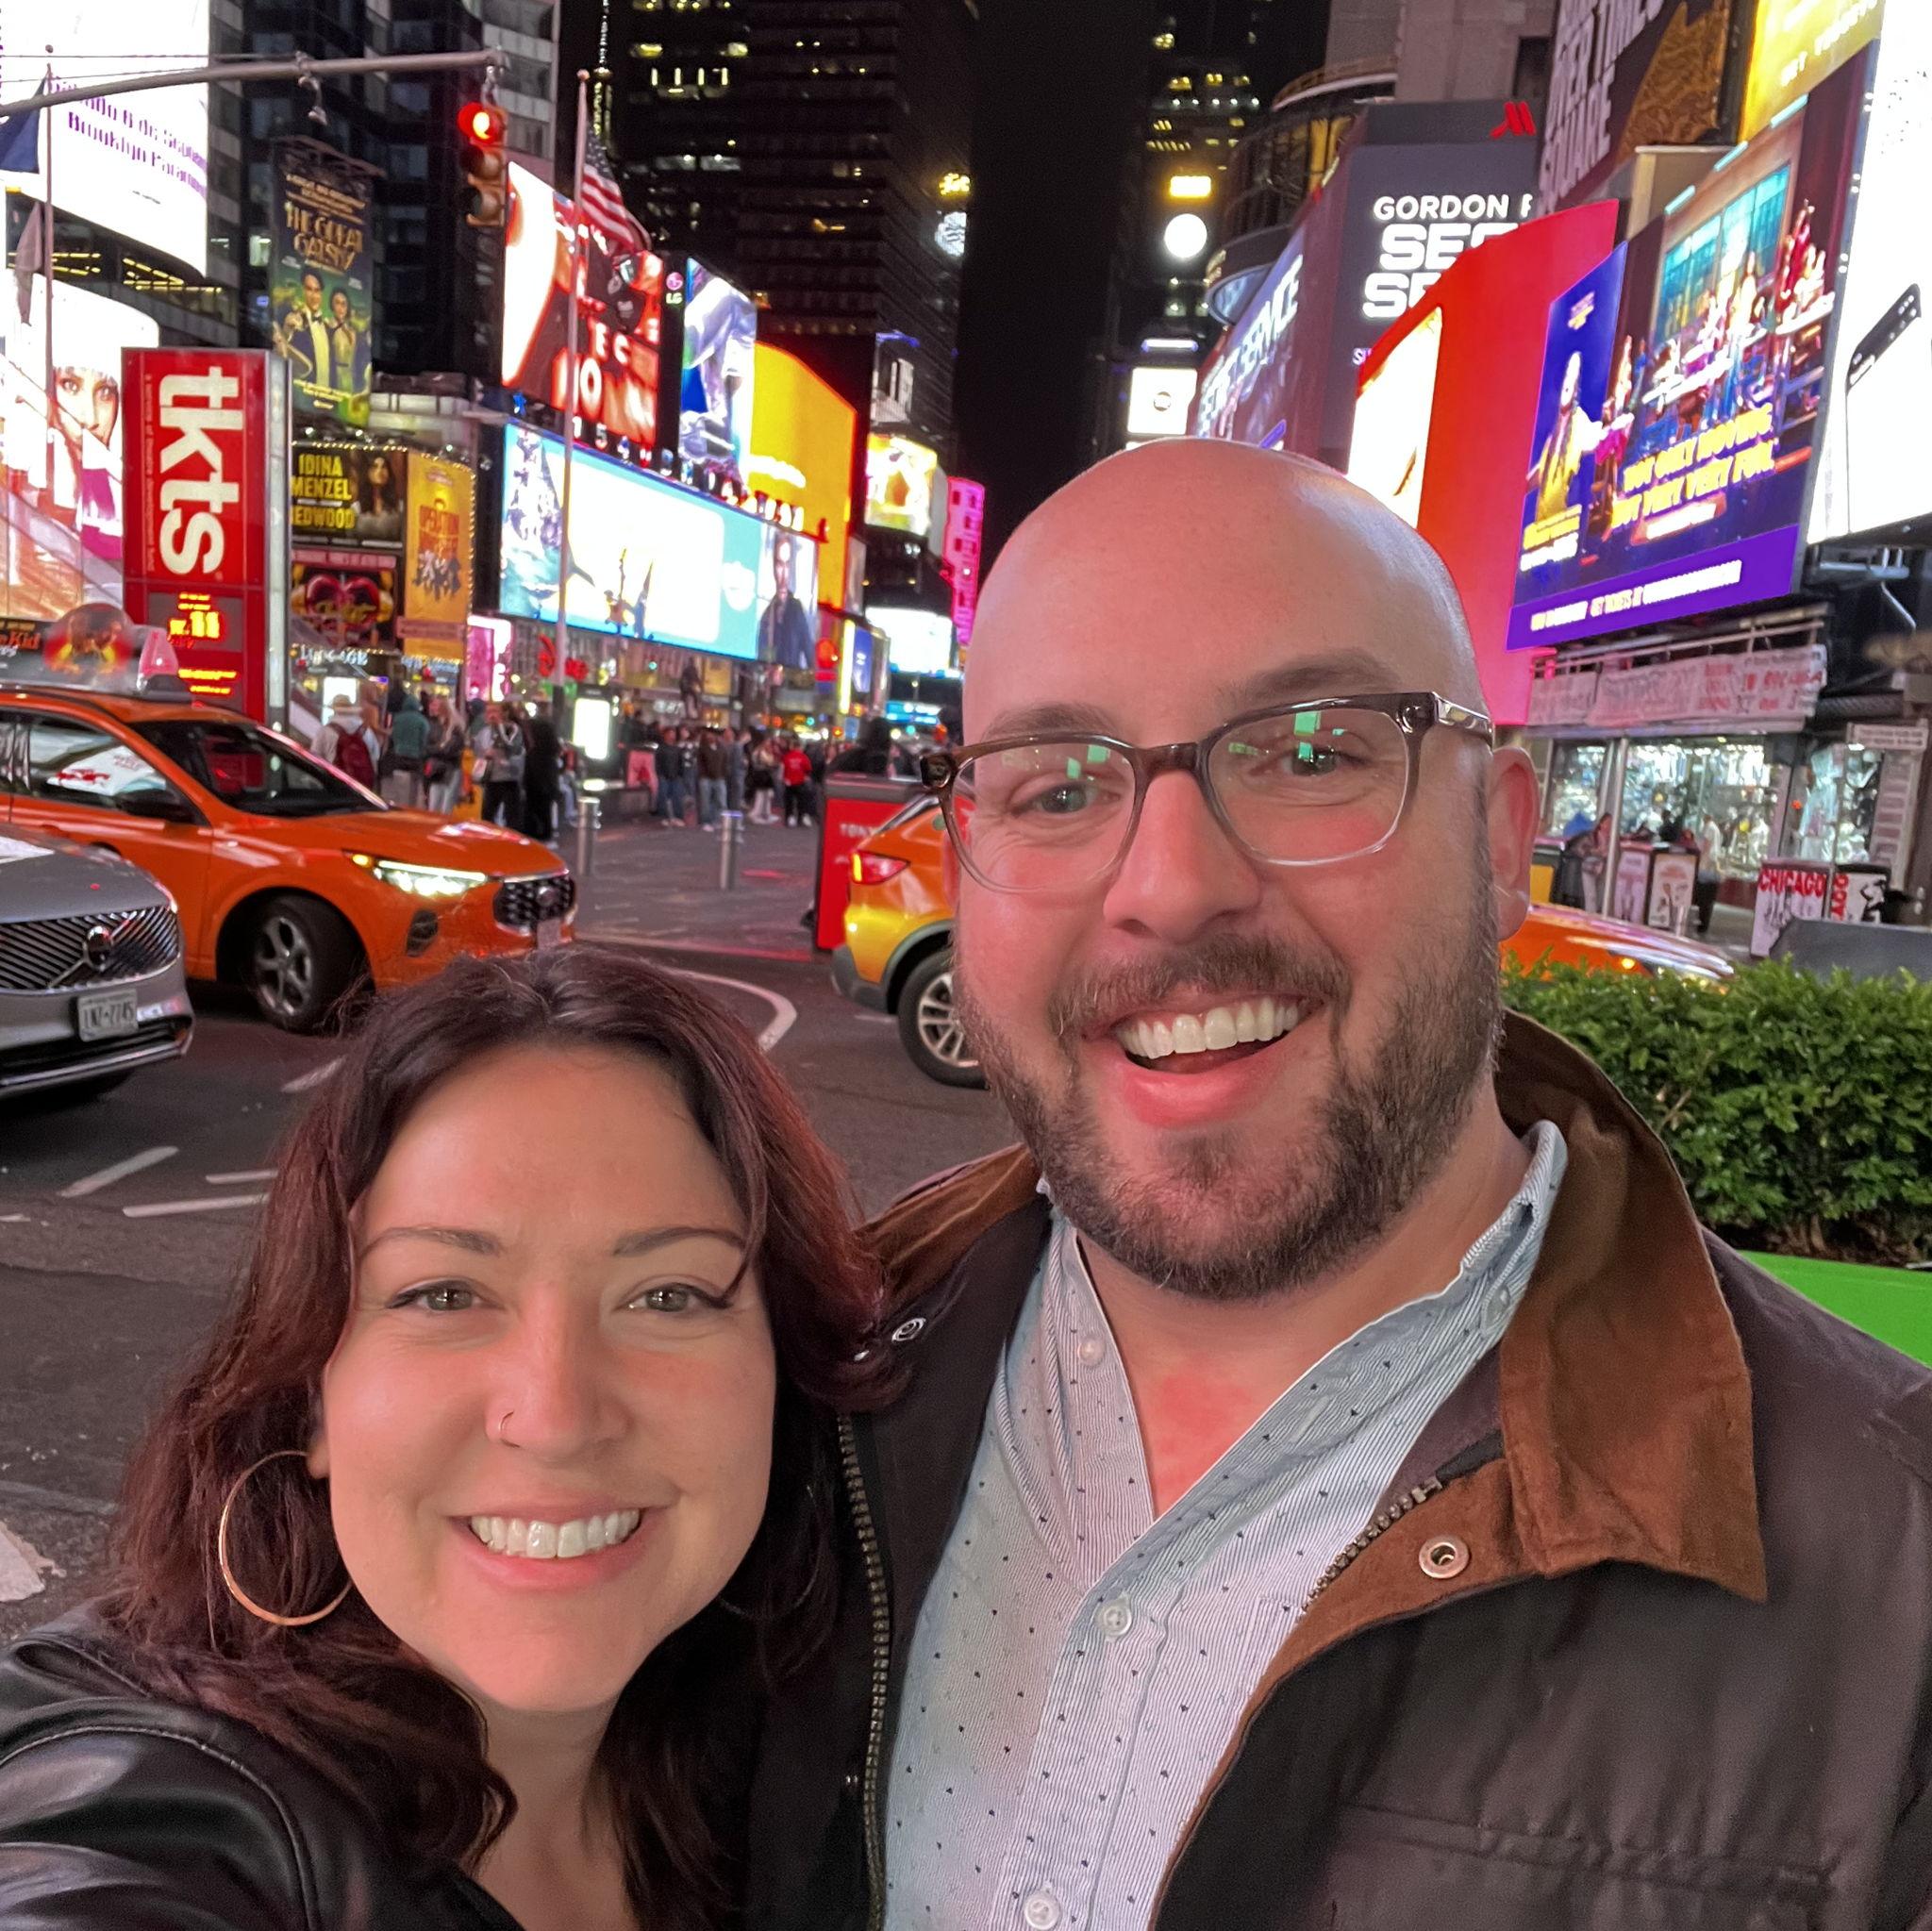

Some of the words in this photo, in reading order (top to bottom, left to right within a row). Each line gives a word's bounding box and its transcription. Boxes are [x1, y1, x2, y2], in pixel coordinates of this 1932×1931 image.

[1373, 193, 1509, 221] GORDON
[665, 292, 683, 305] LG
[158, 365, 244, 574] tkts
[298, 454, 343, 476] IDINA
[291, 475, 353, 501] MENZEL
[1757, 868, 1827, 897] CHICAGO
